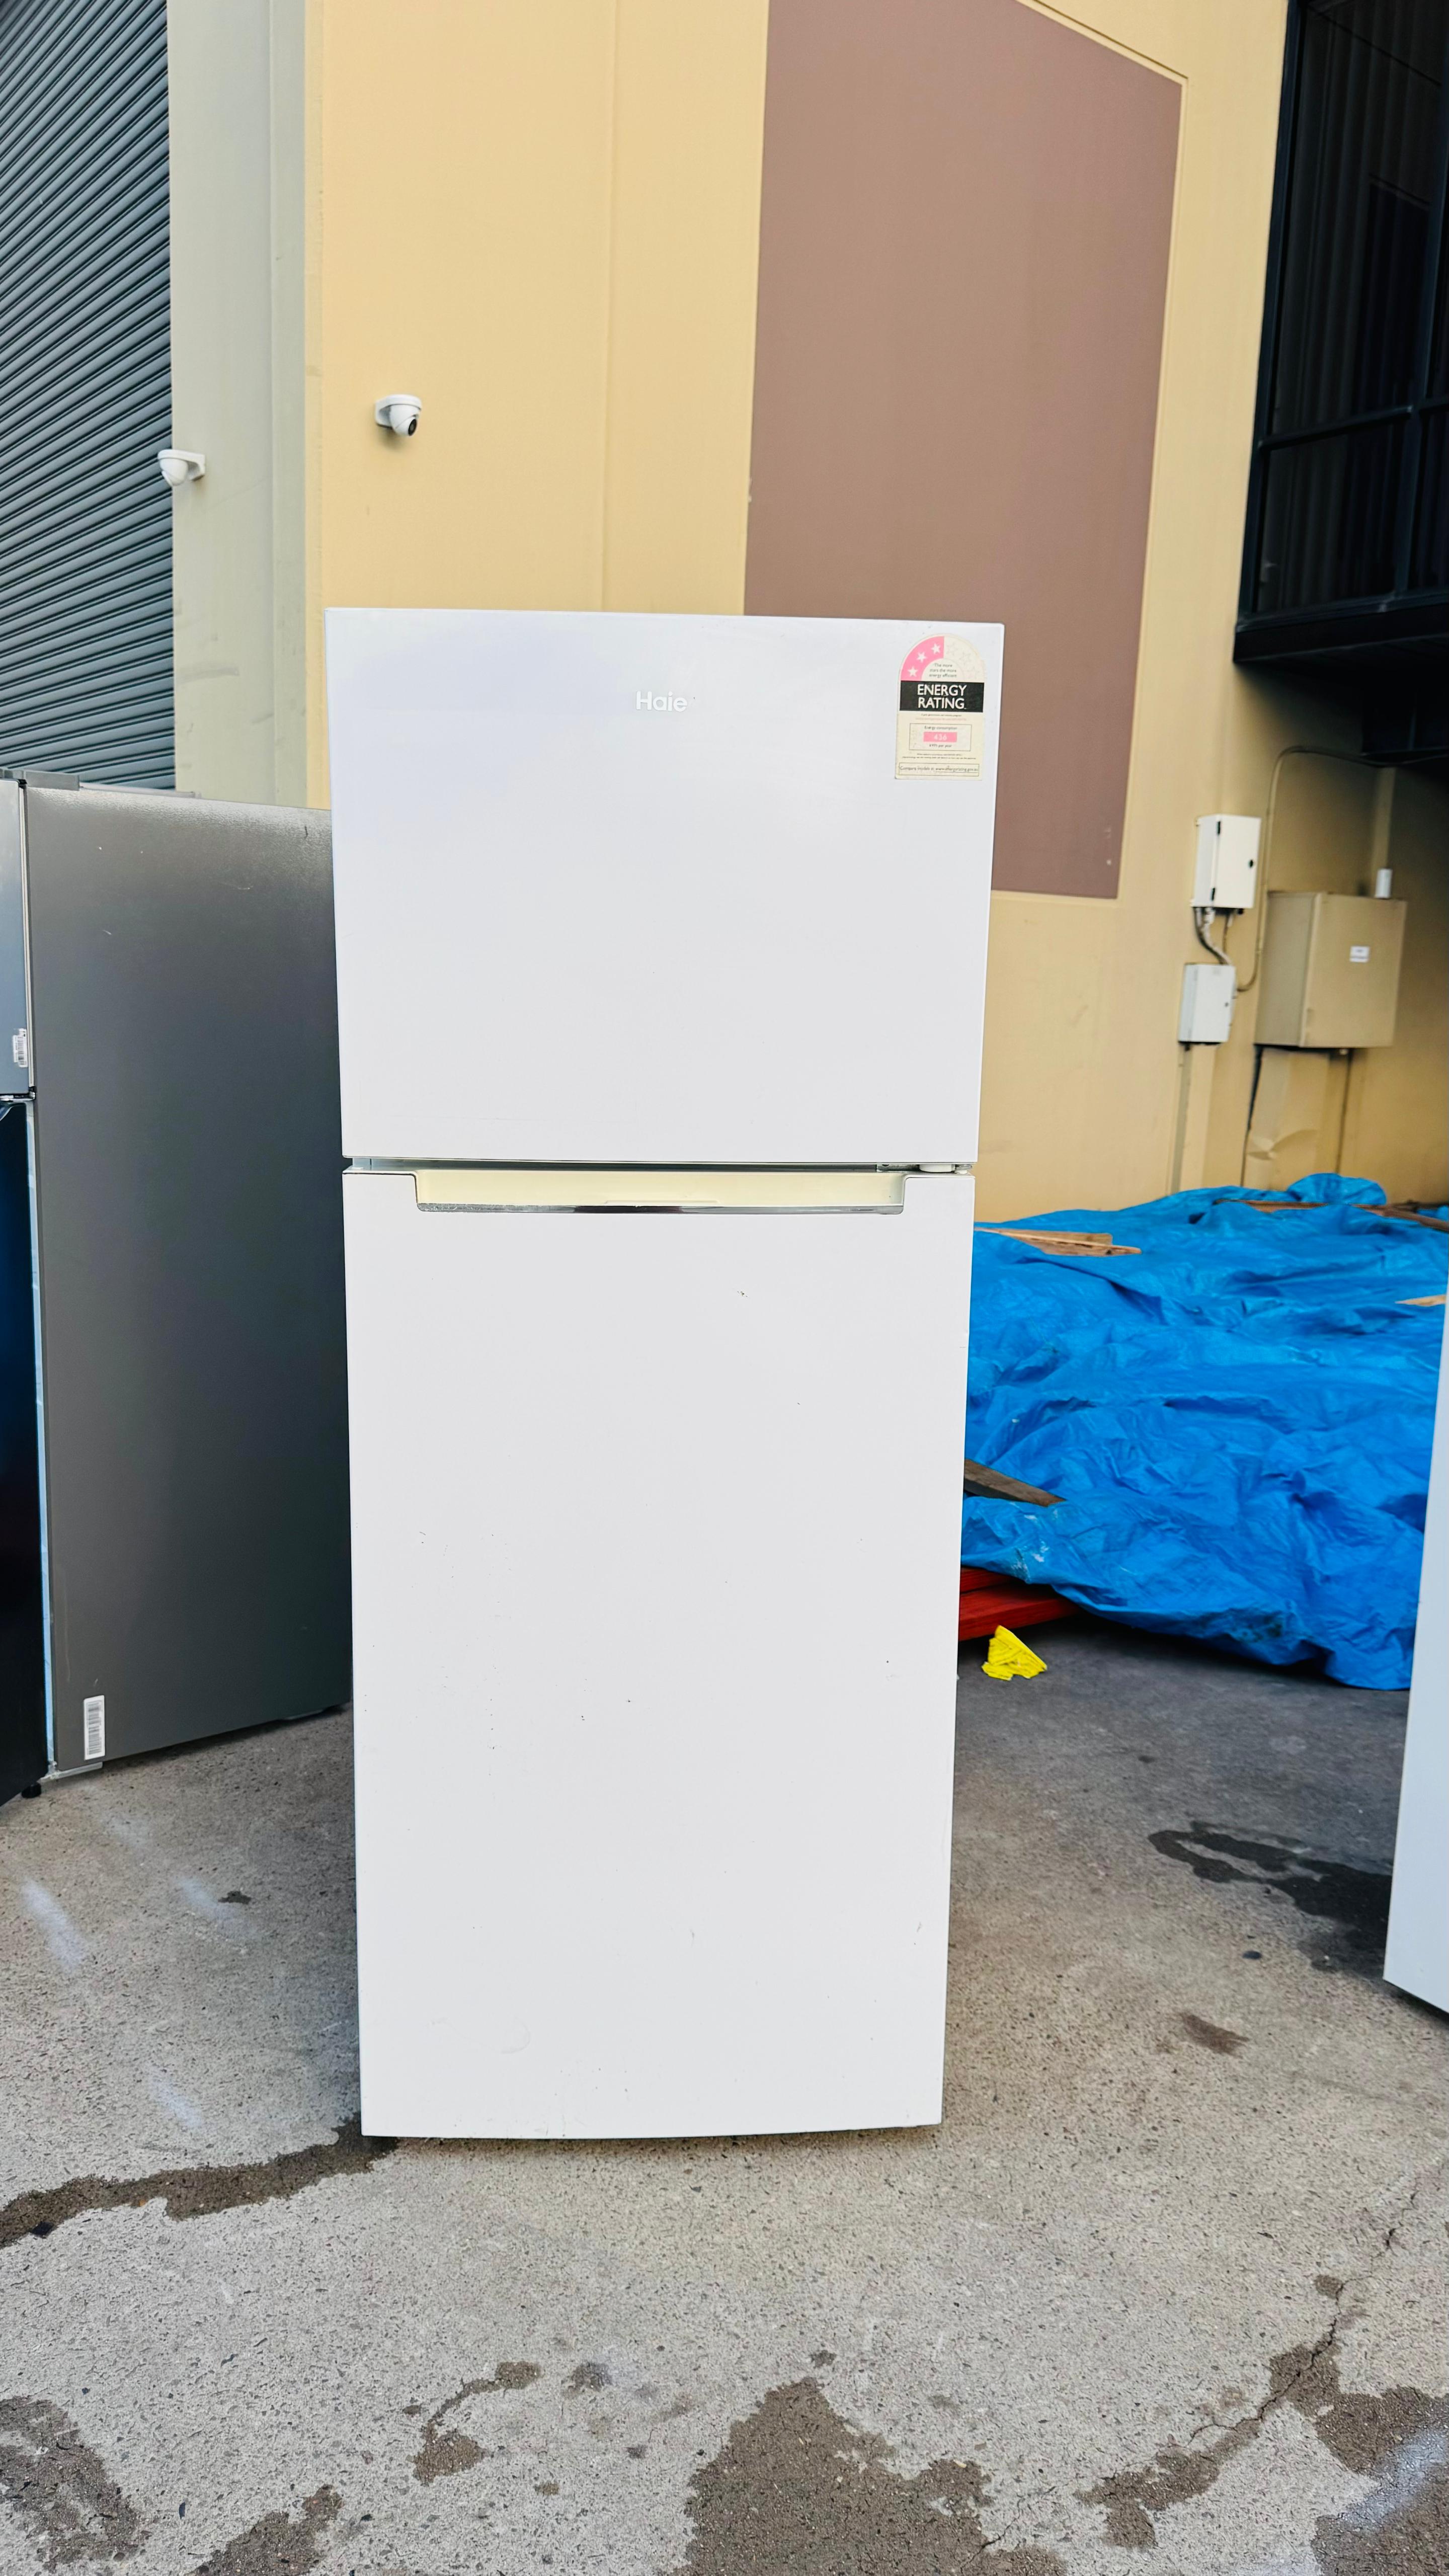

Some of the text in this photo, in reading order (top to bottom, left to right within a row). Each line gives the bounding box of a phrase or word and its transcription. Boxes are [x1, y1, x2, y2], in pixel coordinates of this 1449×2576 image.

[917, 684, 967, 696] ENERGY
[636, 691, 688, 712] Haie
[918, 697, 965, 709] RATING
